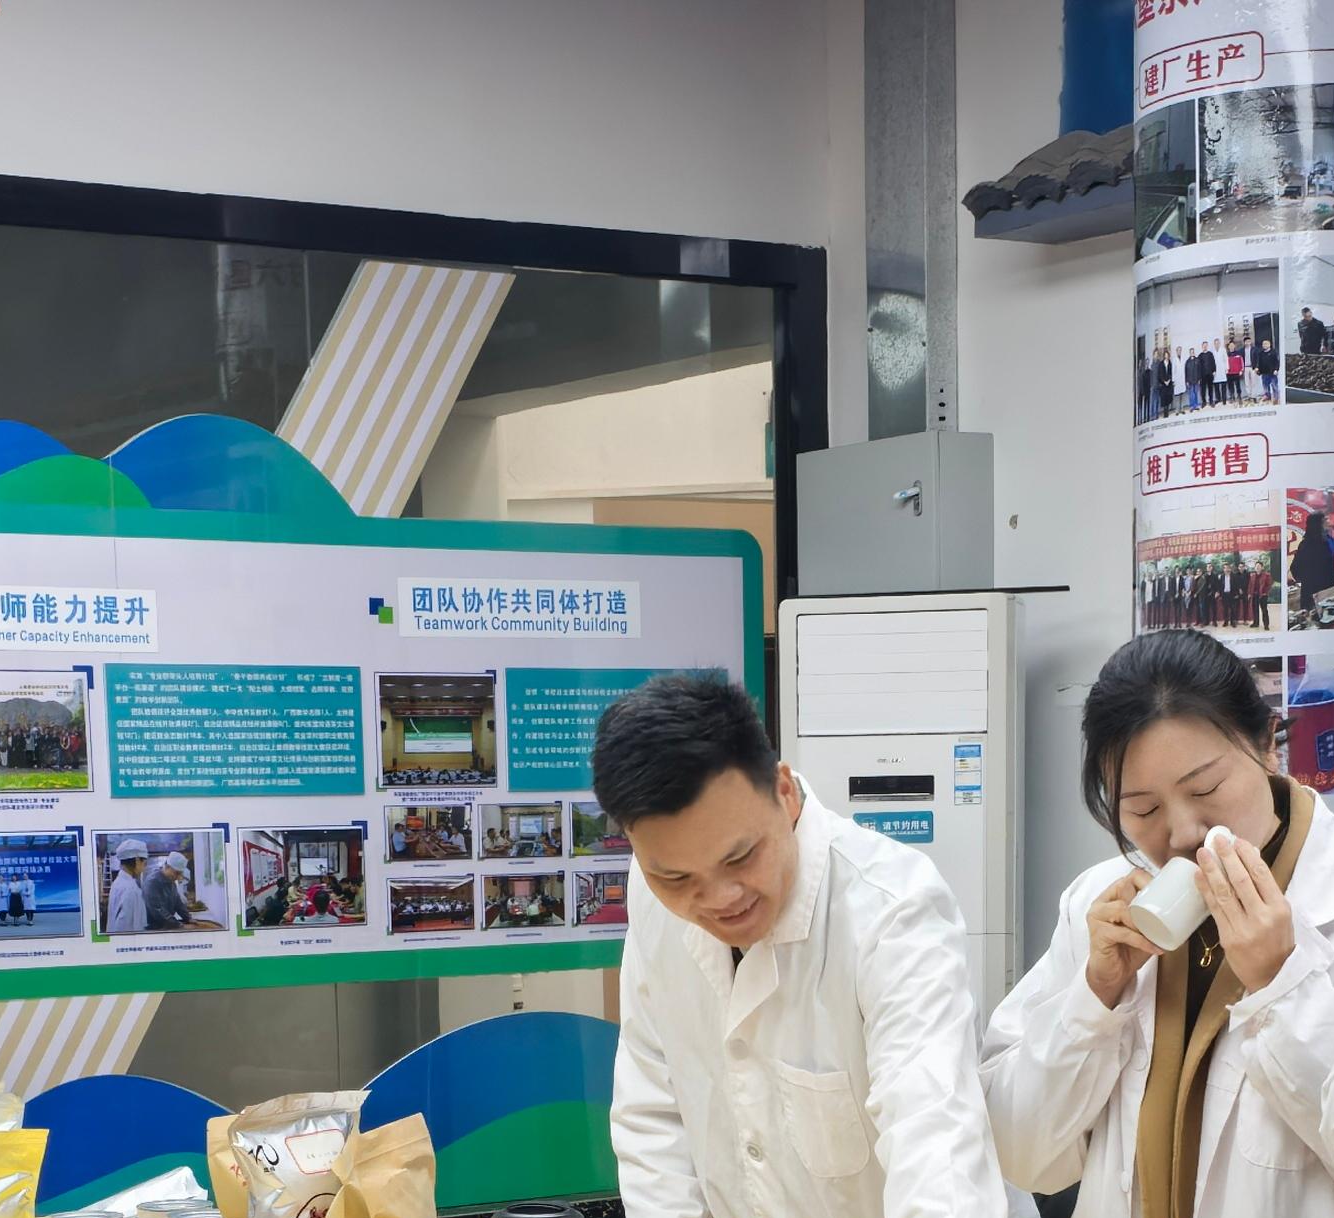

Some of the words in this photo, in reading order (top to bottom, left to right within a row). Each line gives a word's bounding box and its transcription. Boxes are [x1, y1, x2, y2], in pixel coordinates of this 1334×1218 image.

[1143, 43, 1245, 97] 建厂生产
[1147, 443, 1250, 486] 推广销售
[412, 586, 627, 615] 团队协作共同体打造
[20, 630, 69, 644] Capacity
[73, 631, 150, 644] Enhancement
[414, 615, 488, 631] Teamwork
[491, 616, 570, 634] Community
[574, 618, 628, 634] Building
